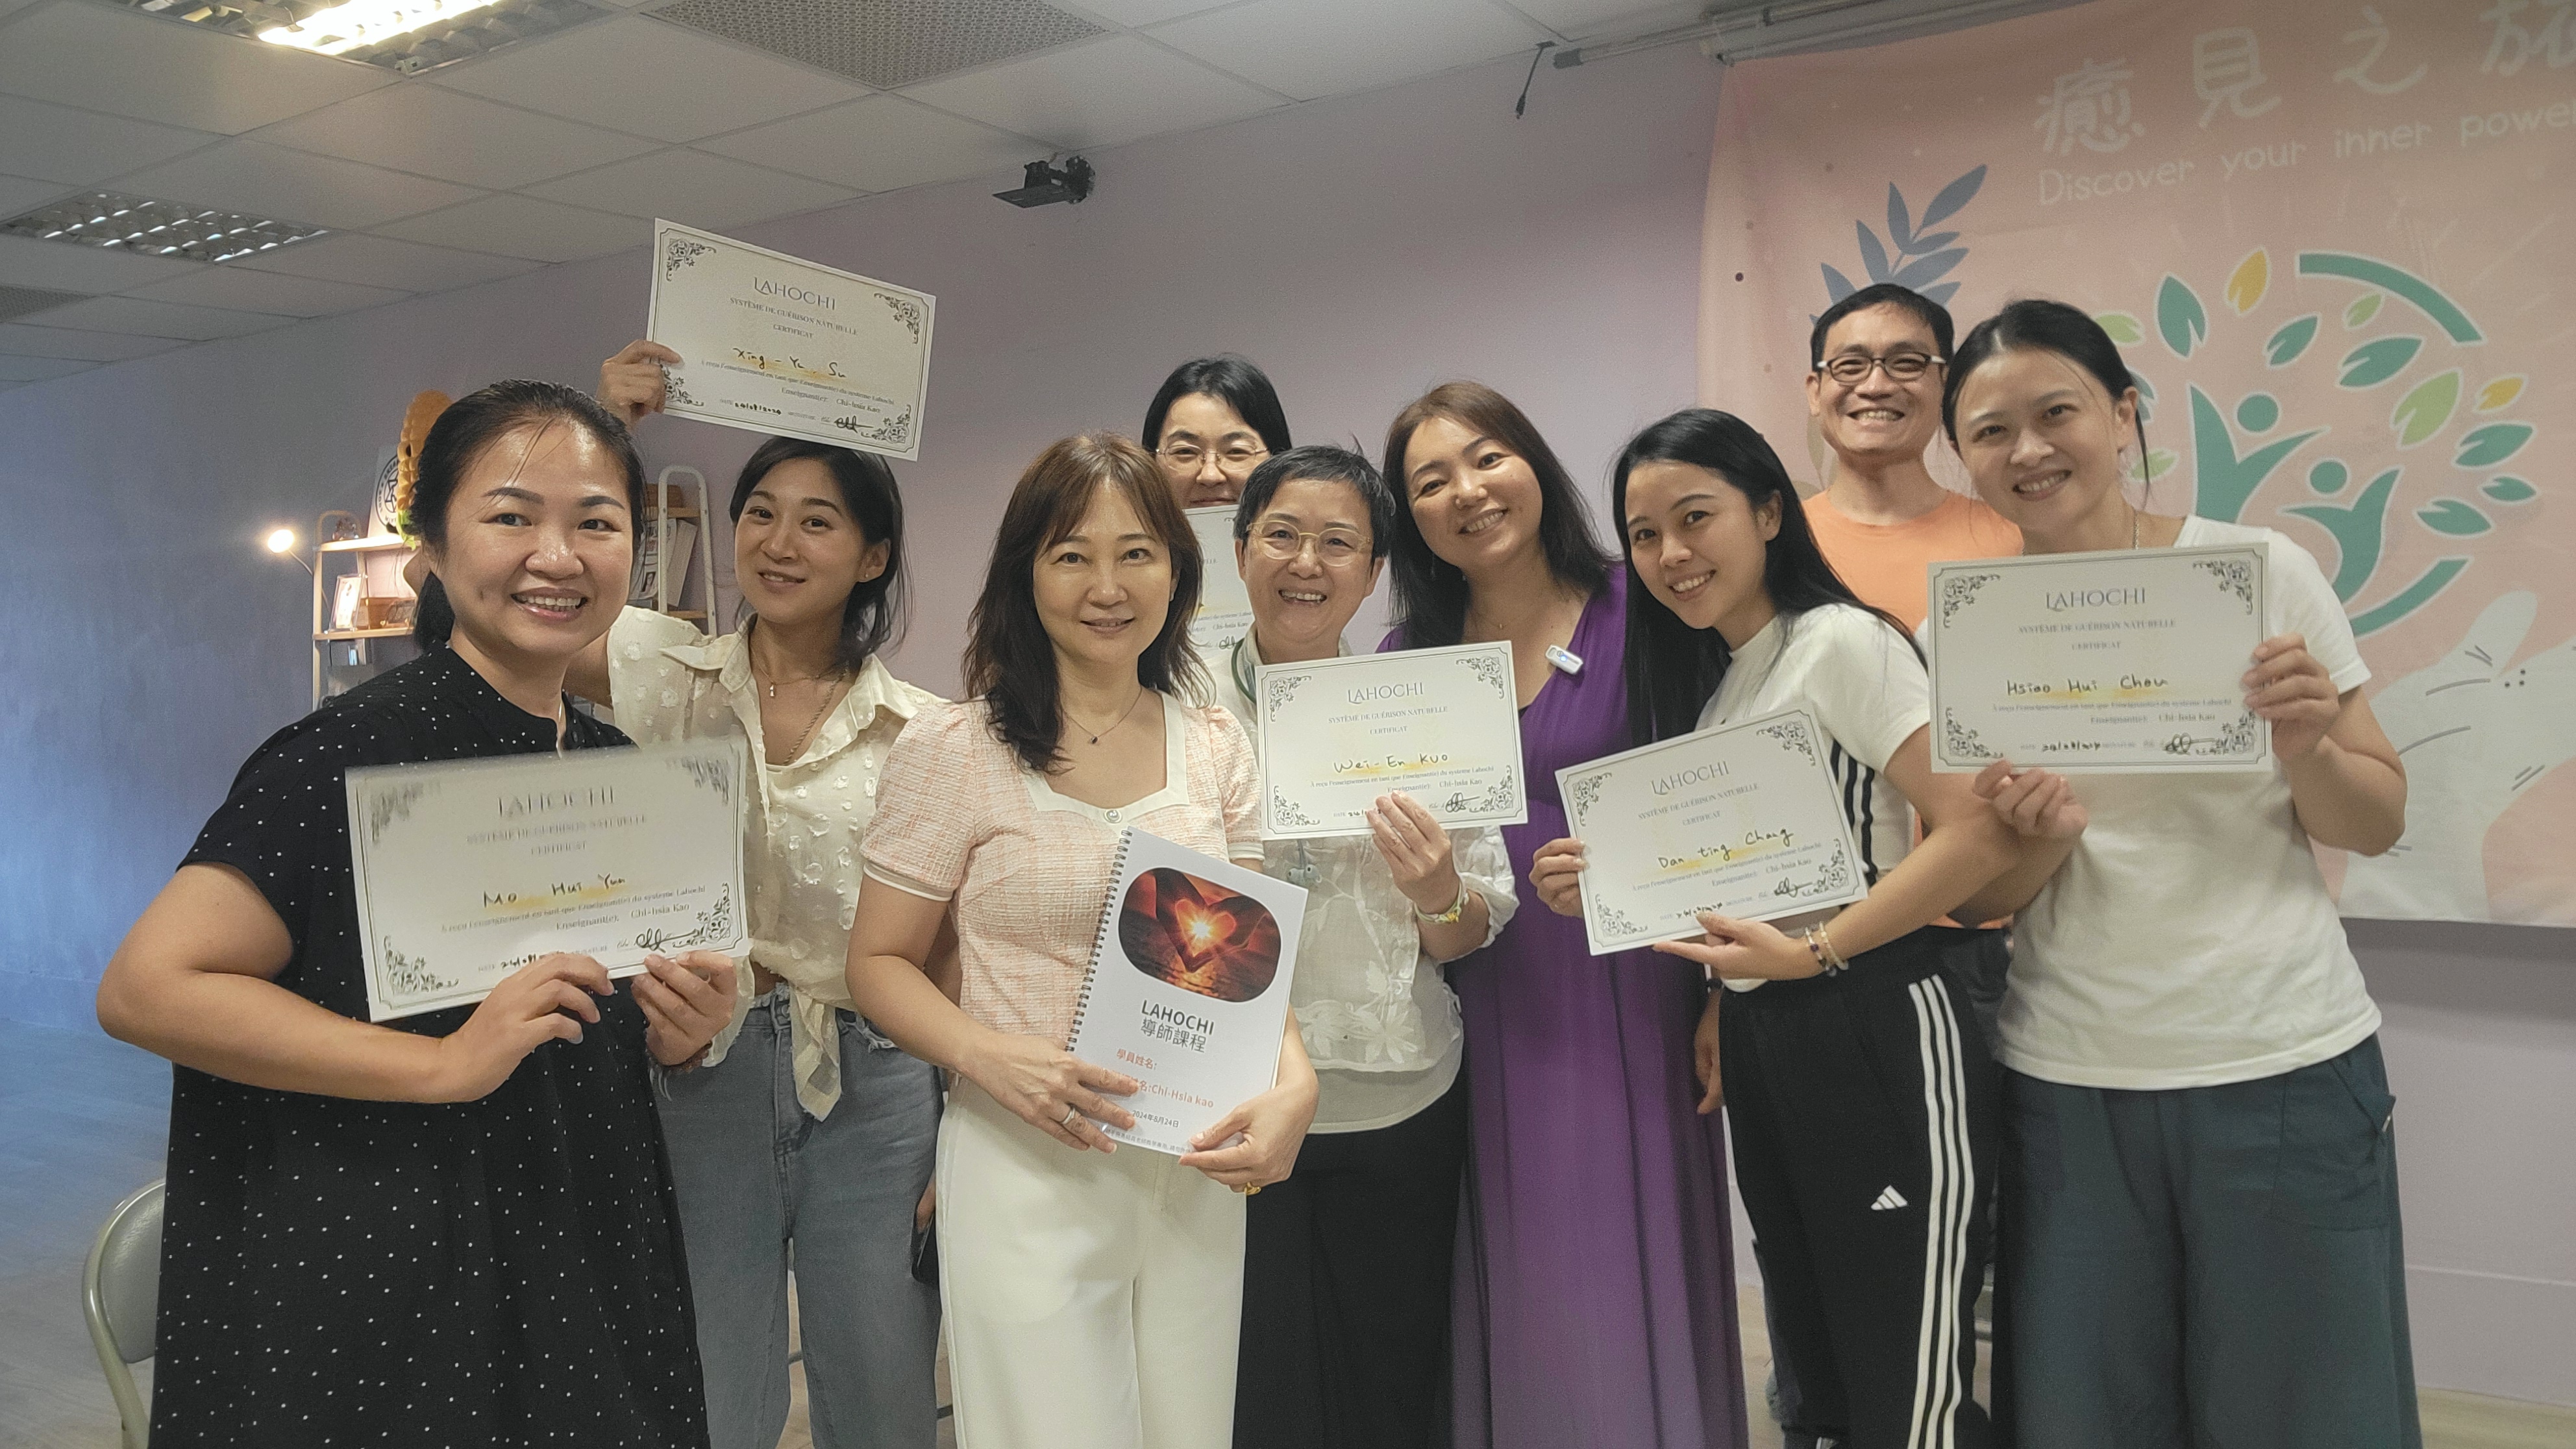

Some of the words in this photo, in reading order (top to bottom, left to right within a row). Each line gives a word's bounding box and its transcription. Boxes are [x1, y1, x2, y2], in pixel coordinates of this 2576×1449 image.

[2038, 158, 2195, 206] Discover
[2220, 140, 2307, 181] your
[2335, 121, 2432, 159] inner
[754, 277, 836, 311] LAHOCHI
[773, 323, 814, 340] CERTIFICAT
[2046, 587, 2146, 612] LAHOCHI
[1348, 682, 1424, 704] LAHOCHI
[2007, 677, 2051, 696] Hsiao
[2067, 676, 2098, 694] Hui
[1360, 712, 1370, 721] DE
[1369, 724, 1408, 735] CERTIFICAT
[1652, 760, 1729, 795] LAHOCHI
[1658, 854, 1684, 869] Dan
[482, 885, 519, 908] Mo
[1141, 999, 1215, 1036] LAHOCHI
[1140, 1017, 1207, 1053] 導師課程
[1132, 1110, 1179, 1128] 2024年8月24日
